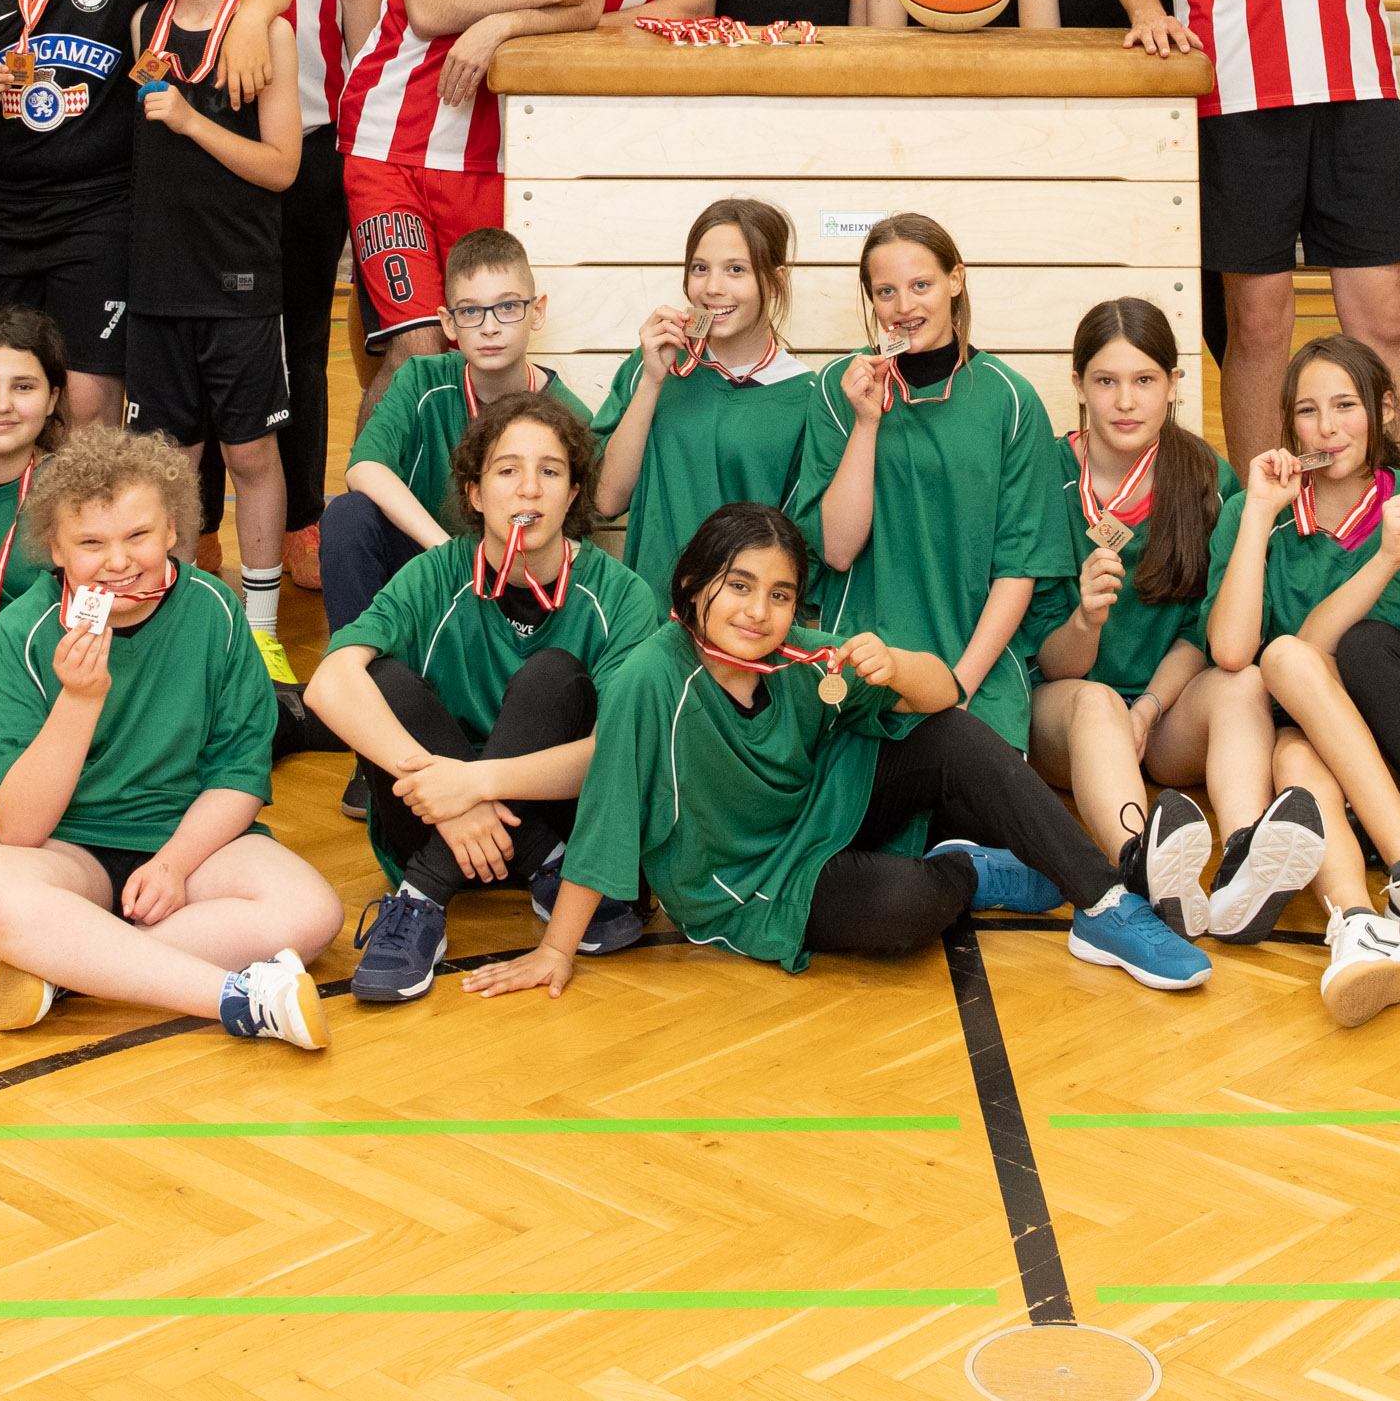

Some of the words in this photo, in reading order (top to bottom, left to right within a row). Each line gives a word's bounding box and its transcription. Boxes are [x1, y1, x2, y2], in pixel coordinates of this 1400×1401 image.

[355, 211, 429, 264] CHICAGO
[840, 223, 873, 232] MEIXN
[383, 253, 414, 304] 8
[125, 399, 140, 424] P
[265, 409, 290, 427] JAKO
